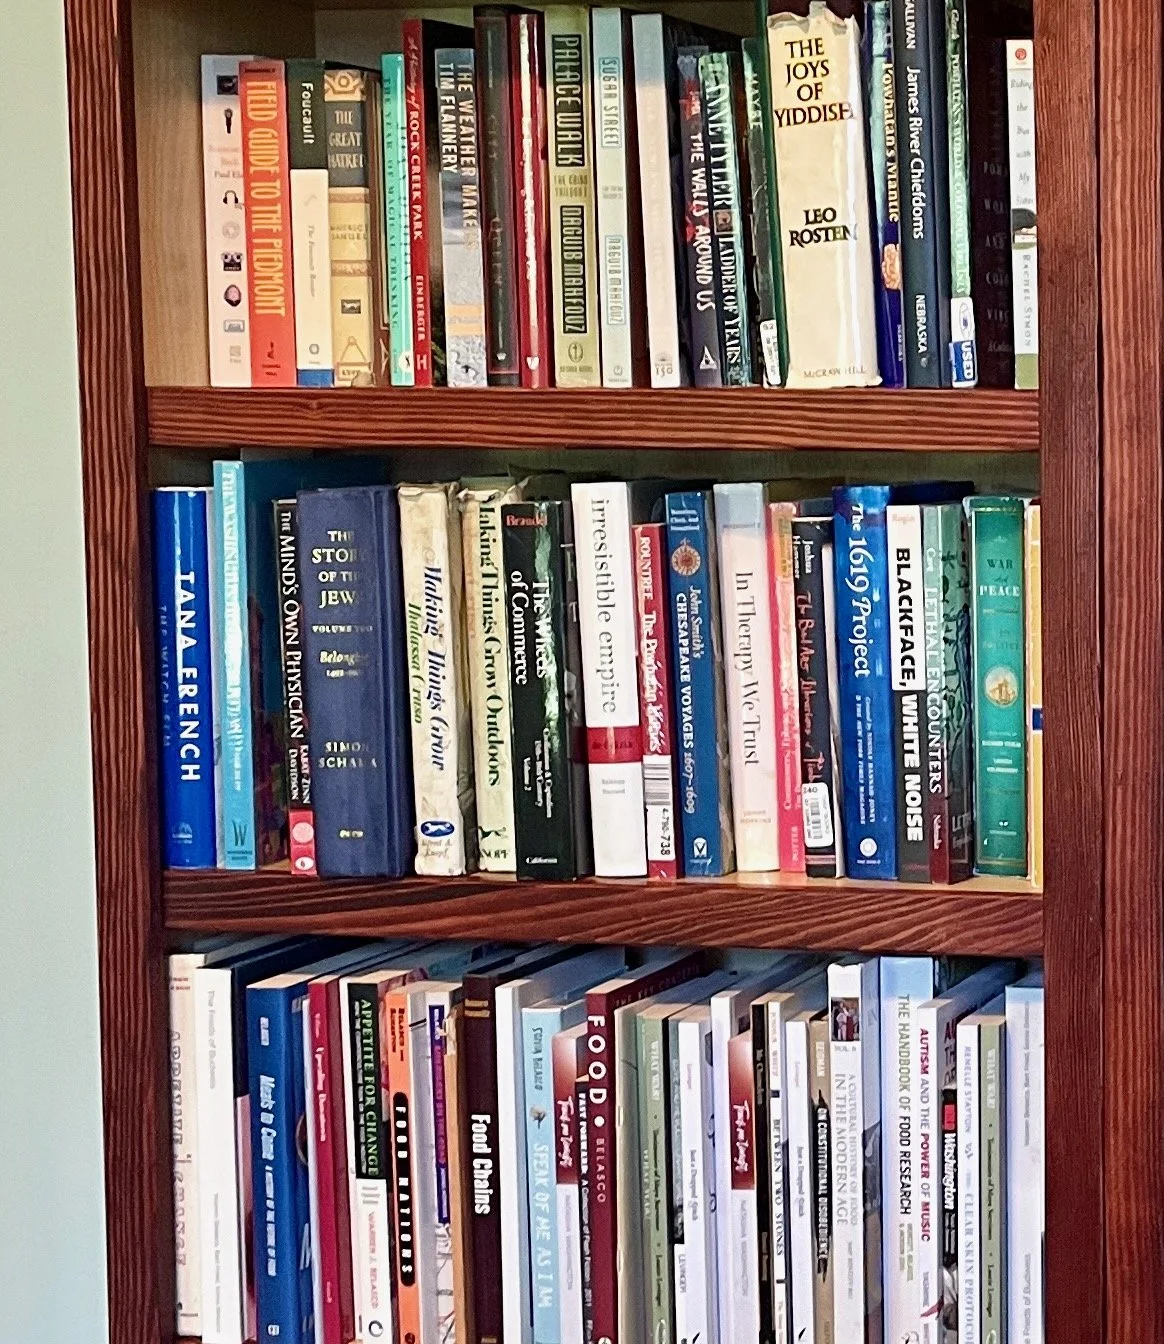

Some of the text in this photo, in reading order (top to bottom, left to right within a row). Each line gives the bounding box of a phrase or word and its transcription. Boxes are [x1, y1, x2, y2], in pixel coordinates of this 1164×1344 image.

[247, 81, 277, 121] FIELD
[554, 37, 583, 165] PALACE WALK
[785, 37, 825, 57] THE
[786, 59, 830, 87] JOYS
[797, 82, 824, 102] OF
[905, 66, 921, 114] James
[248, 127, 279, 174] GUIDE
[301, 83, 315, 144] Foucault
[439, 63, 458, 174] TIM FLANNERY
[456, 63, 477, 177] THE WEATHER
[705, 80, 732, 205] ANNE TYLER
[774, 102, 854, 128] YIDDISH
[907, 117, 922, 154] River
[250, 179, 281, 199] TO
[252, 203, 281, 232] THE
[409, 111, 423, 240] ROCK CREEK PARK
[689, 133, 716, 311] THE WALLS AROUND US
[804, 207, 837, 226] LEO
[909, 158, 926, 239] Chiefdoms
[253, 238, 285, 316] PIEDMONT
[561, 208, 586, 333] NAGUIB MAHFOUZ
[790, 225, 857, 247] ROSTEN
[718, 237, 741, 363] LADDER OF YEARS
[914, 294, 928, 353] NEBRASKA
[960, 342, 973, 379] USED
[280, 512, 304, 739] THE MIND'S OWN PHYSICIAN
[511, 570, 529, 684] of Commerce
[532, 580, 552, 678] The Wheels
[591, 498, 618, 714] irresistible empire
[689, 586, 703, 659] John Smith's
[845, 504, 873, 678] The 1619 Project
[176, 572, 201, 781] TANA FRENCH
[424, 564, 447, 771] Making Things Grow
[676, 593, 697, 814] CHESAPEAKE VOYAGES 1607-1609
[733, 571, 761, 766] In Therapy We Trust
[896, 548, 923, 841] BLACKFACE, WHITE NOISE
[361, 999, 379, 1176] APPETITE FOR CHANGE
[587, 1014, 606, 1203] FOOD BELASCO
[897, 994, 912, 1215] THE HANDBOOK OF FOOD RESEARCH
[396, 1106, 412, 1274] FOOD NATIONS
[471, 1114, 493, 1215] Food Chains
